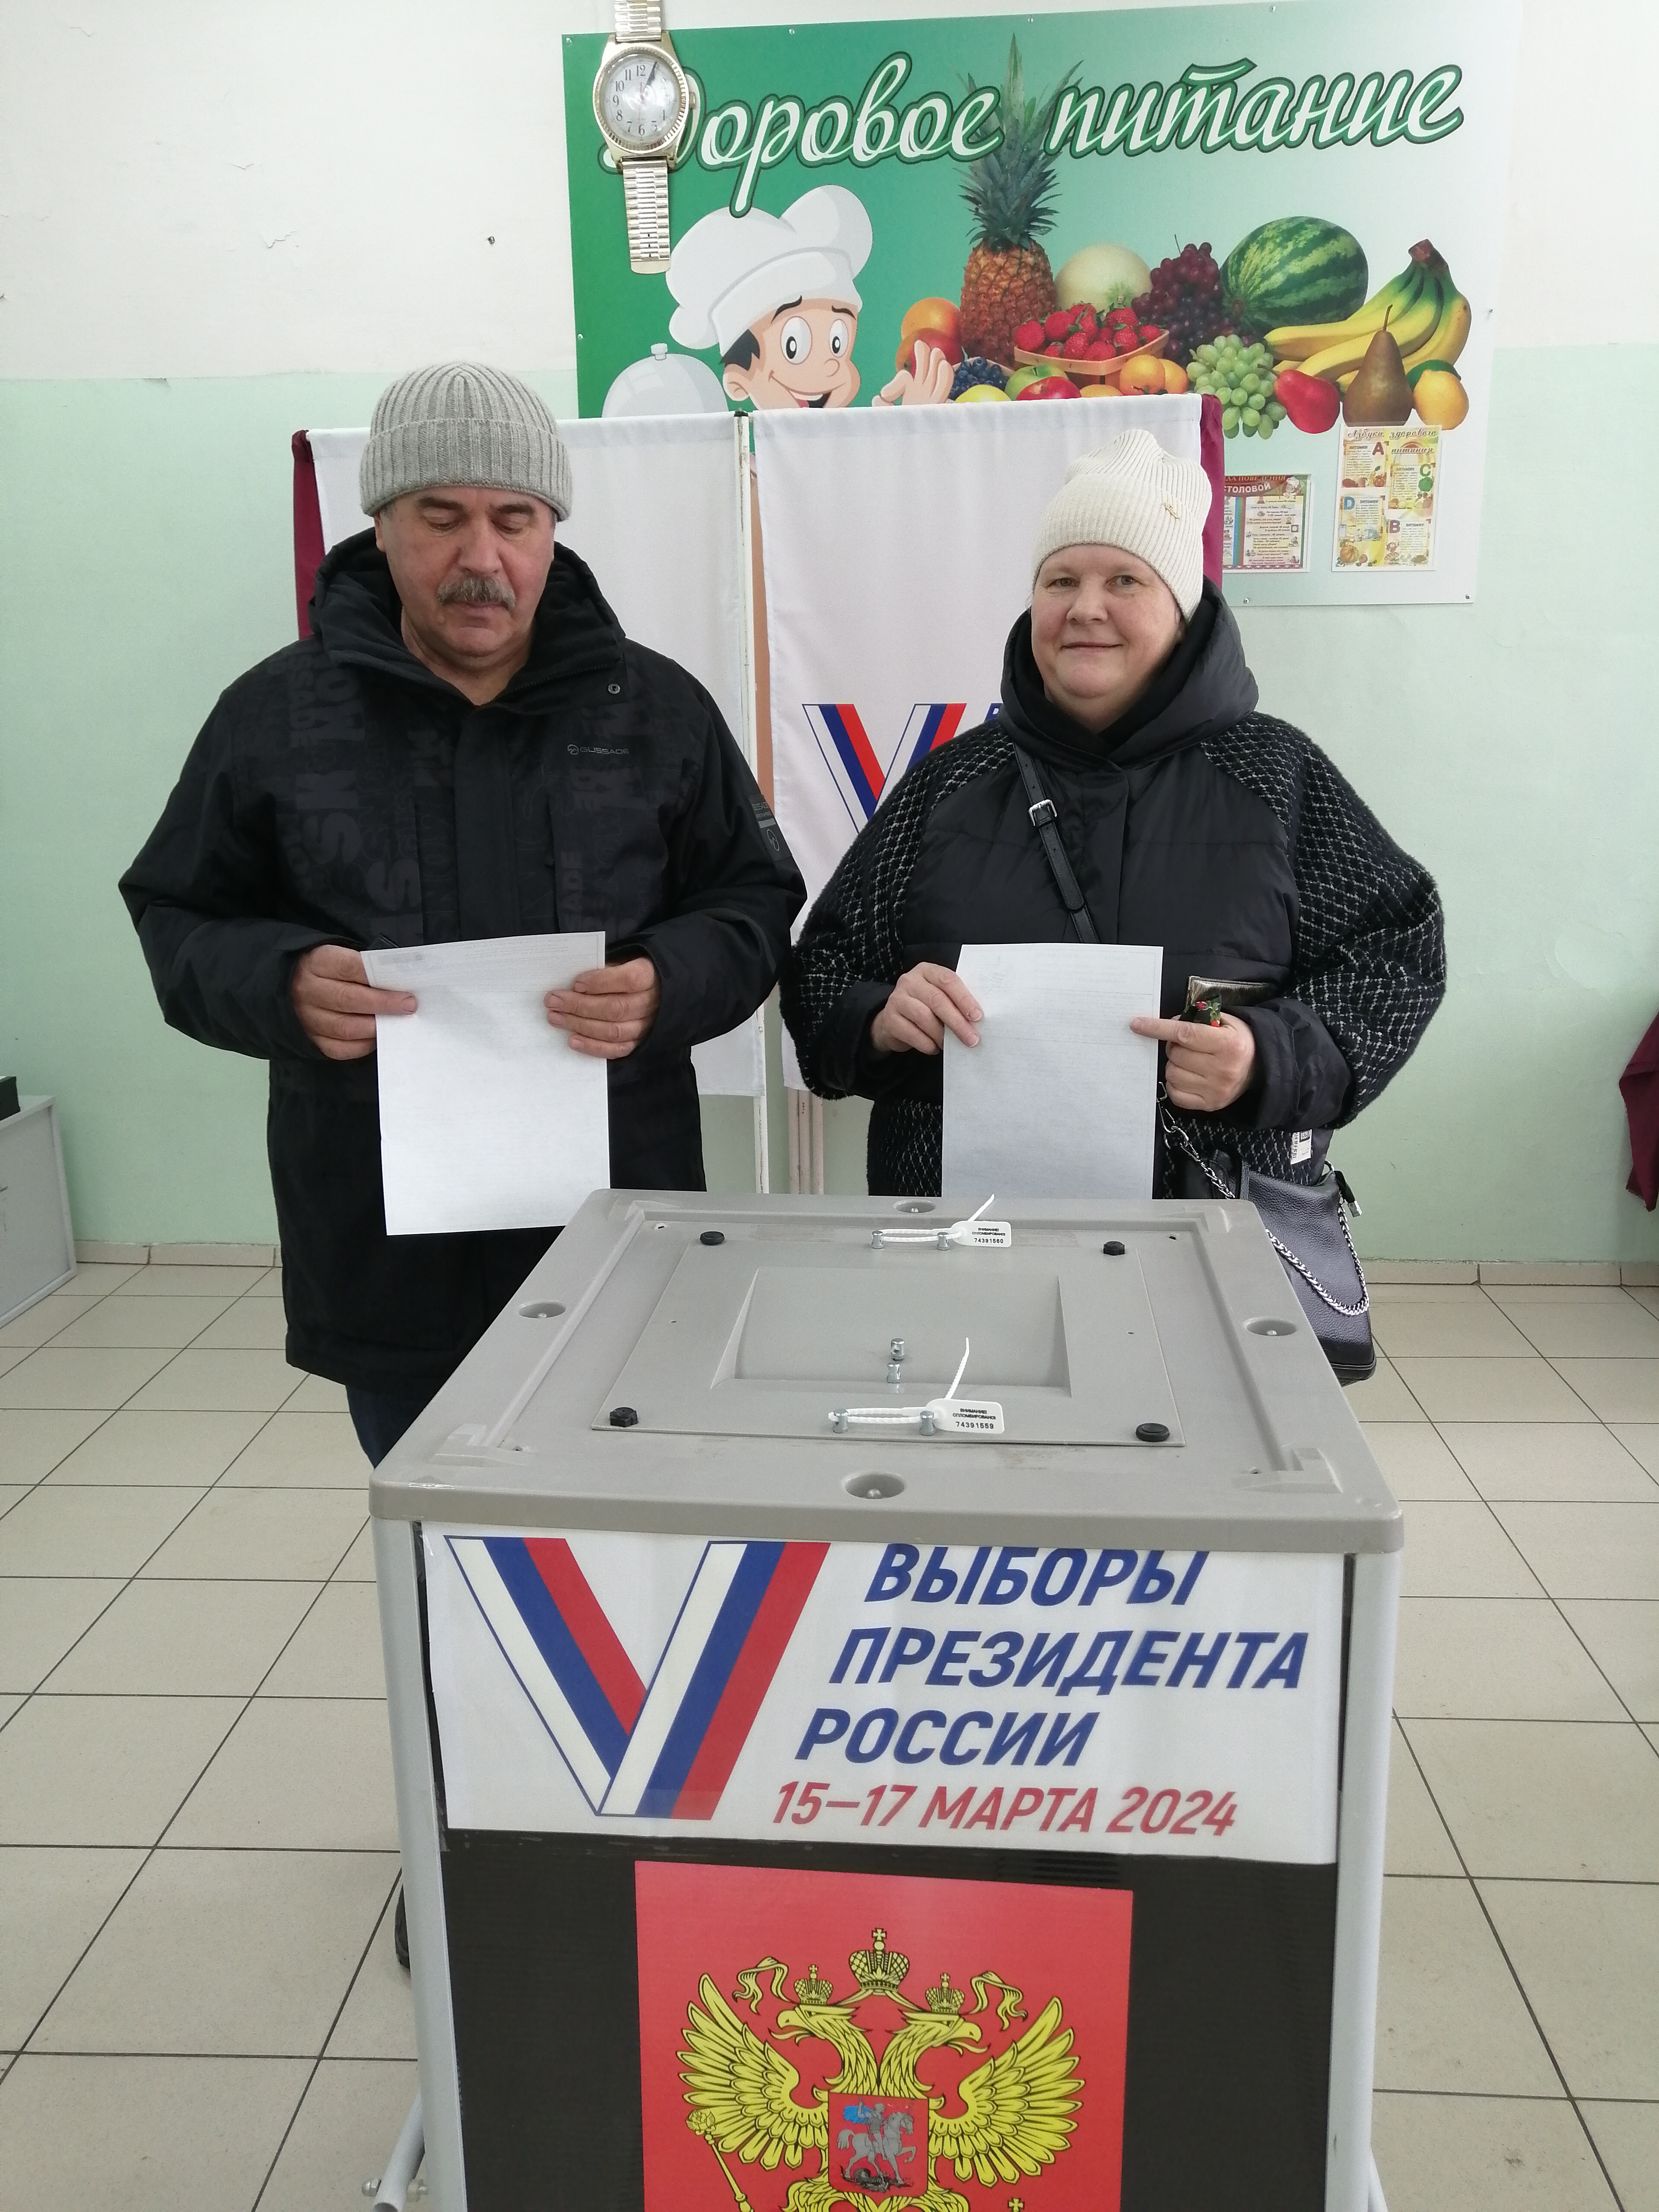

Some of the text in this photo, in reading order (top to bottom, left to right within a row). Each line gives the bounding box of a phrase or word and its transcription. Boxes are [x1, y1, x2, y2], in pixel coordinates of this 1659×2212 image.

[625, 69, 631, 81] 11
[636, 65, 645, 76] 12
[615, 80, 624, 92] 10
[613, 95, 620, 107] 9
[616, 110, 623, 121] 8
[627, 121, 632, 133] 7
[638, 124, 645, 136] 6
[598, 51, 1464, 218] оровое питание
[1348, 428, 1438, 440] Азбука здорового
[1391, 447, 1434, 455] питания
[1344, 497, 1355, 510] D
[955, 1421, 994, 1429] 74391559
[864, 1543, 1208, 1606] ВЫБОРЫ
[830, 1627, 1309, 1696] ПРЕЗИДЕНТА
[795, 1708, 1100, 1766] РОССИИ
[918, 1786, 1098, 1834] МАРТА
[1106, 1786, 1236, 1836] 2024
